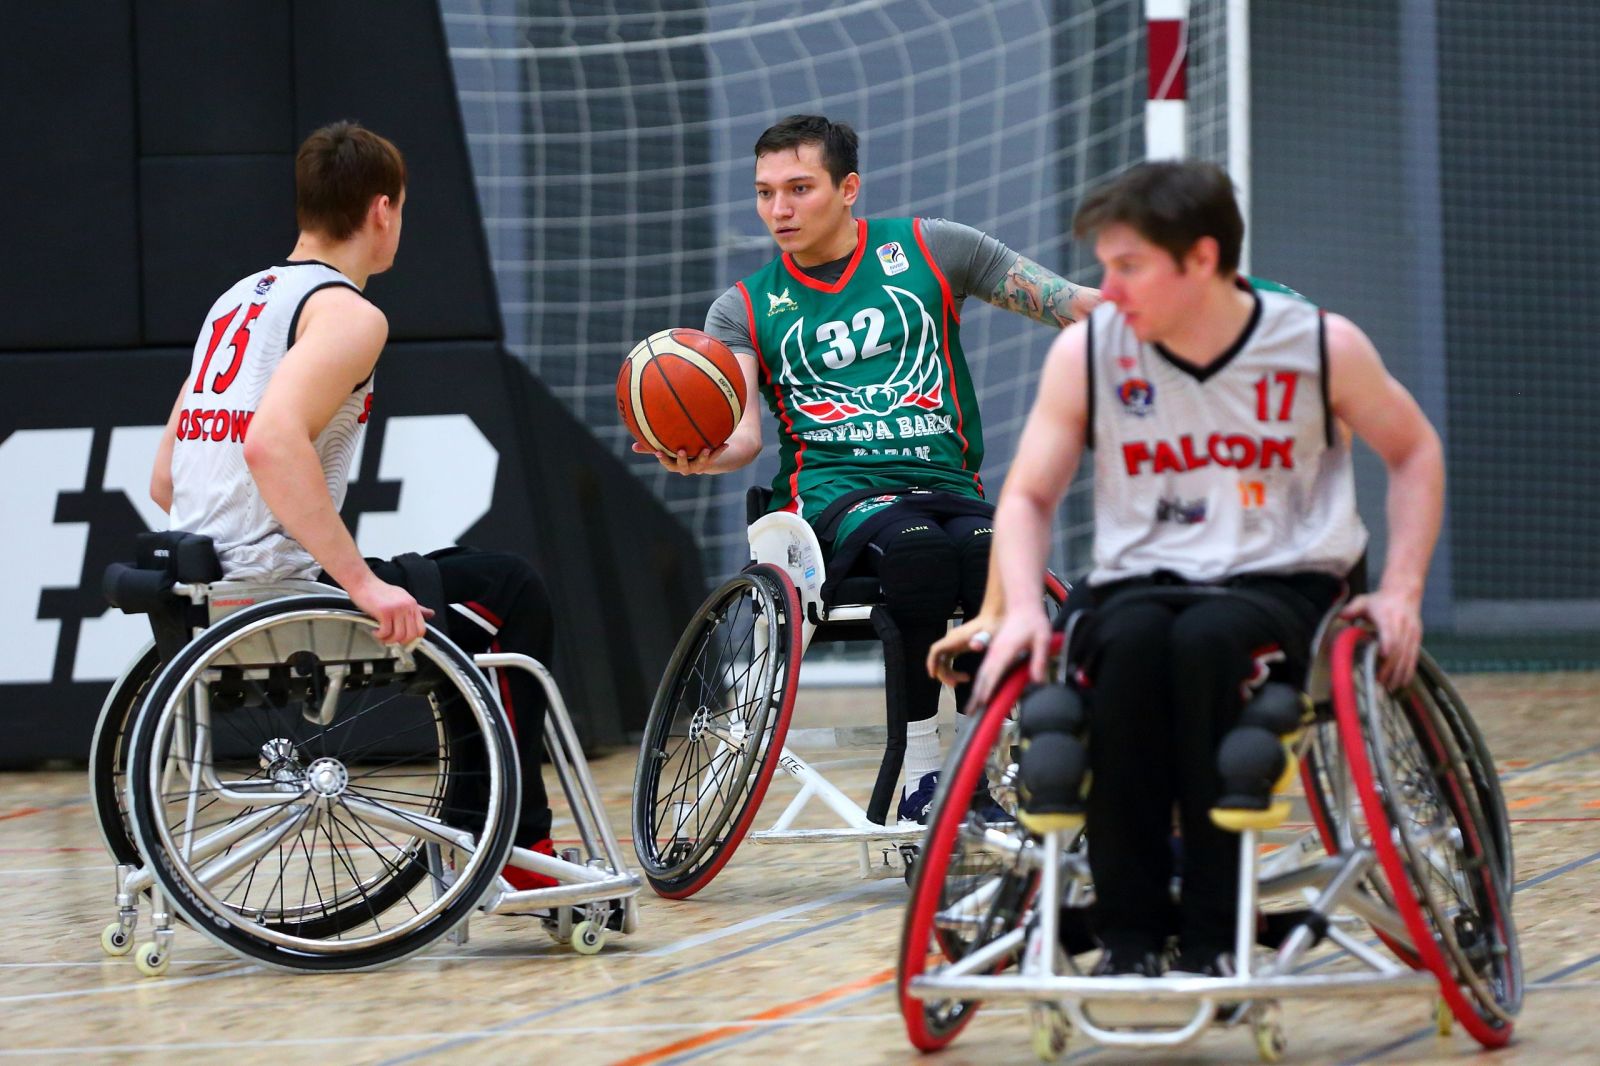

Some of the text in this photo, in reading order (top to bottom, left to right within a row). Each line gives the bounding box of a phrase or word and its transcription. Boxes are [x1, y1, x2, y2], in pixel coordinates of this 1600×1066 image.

[193, 301, 267, 394] 15
[816, 307, 892, 370] 32
[1254, 370, 1298, 422] 17
[176, 408, 255, 443] OSCOW
[1122, 432, 1295, 477] FALCON
